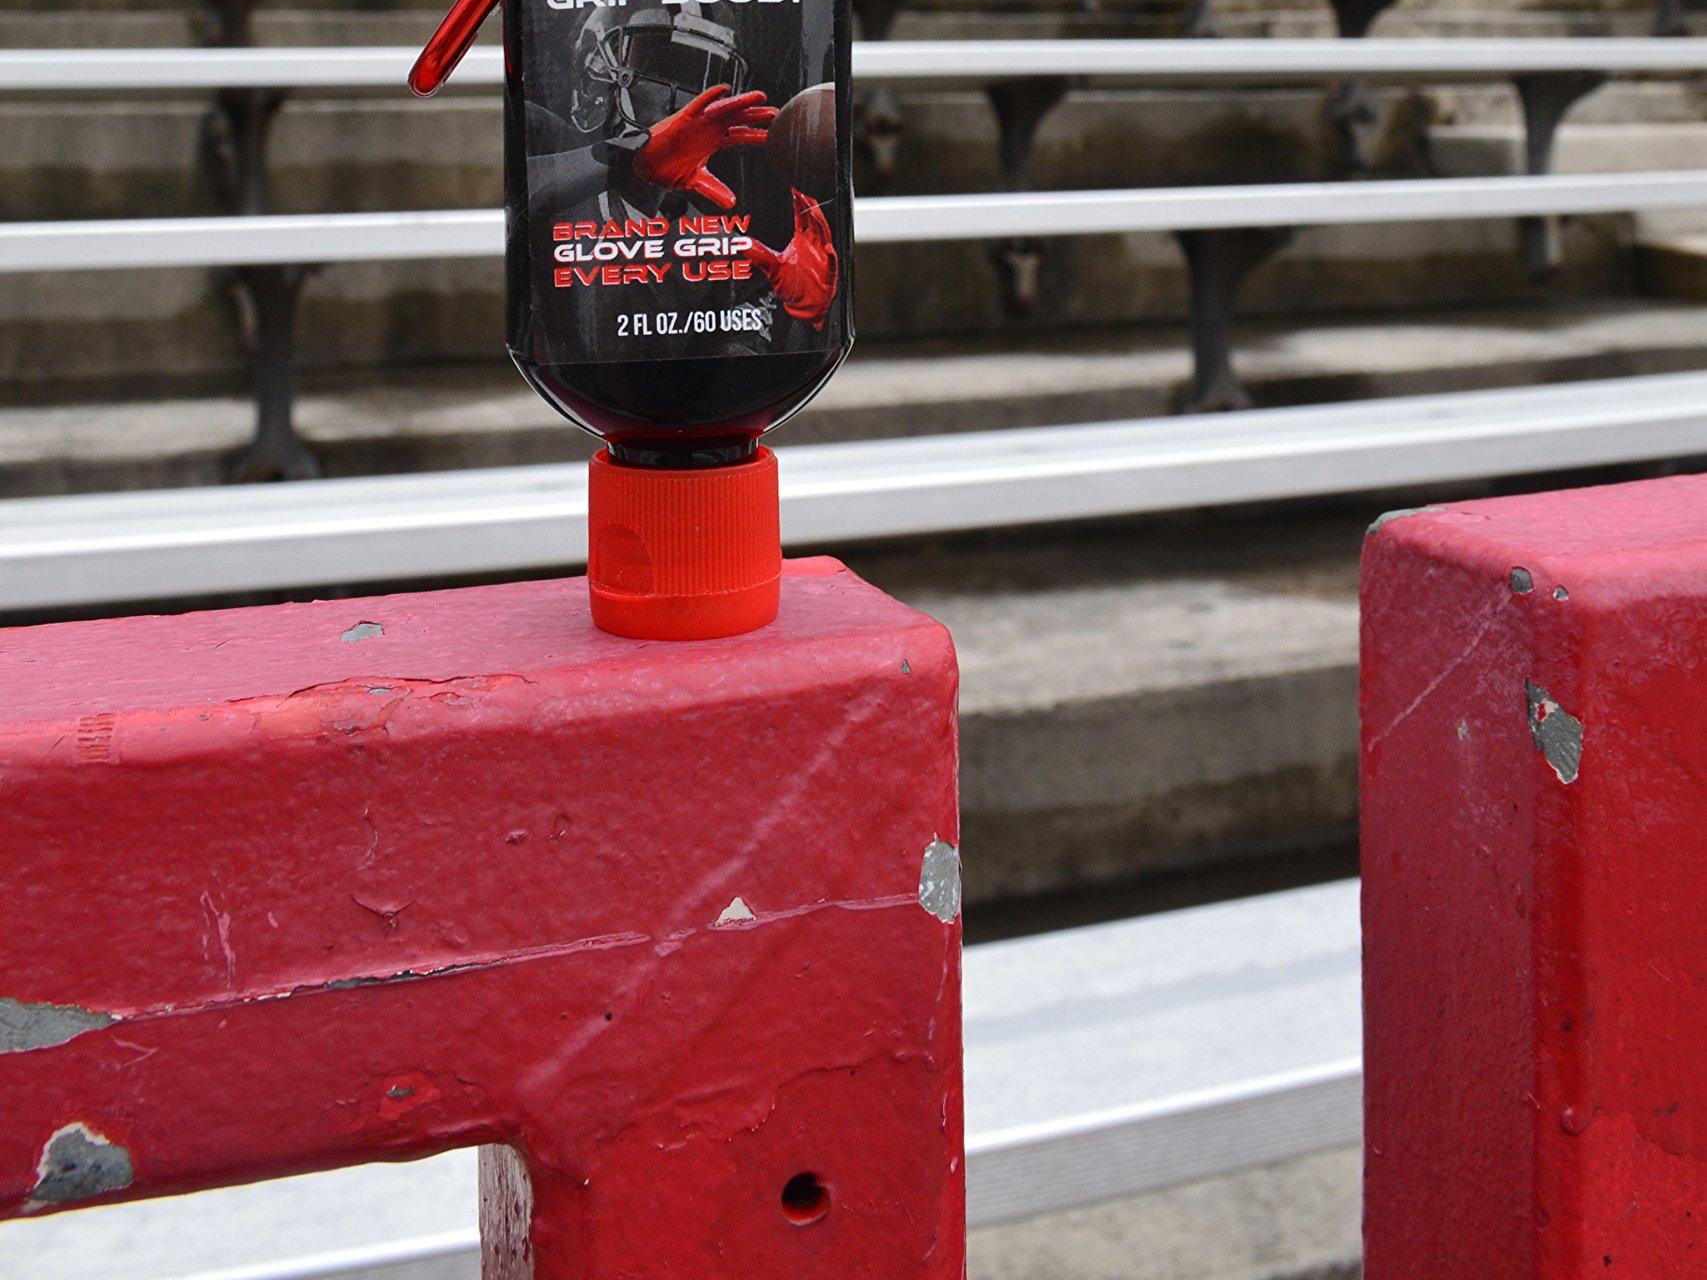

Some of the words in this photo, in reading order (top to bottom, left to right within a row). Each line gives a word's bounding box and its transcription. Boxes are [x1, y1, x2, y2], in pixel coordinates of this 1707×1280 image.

[553, 218, 668, 239] BRAND
[680, 215, 749, 235] NEW
[554, 240, 664, 262] GLOVE
[674, 236, 753, 257] GRIP
[554, 263, 671, 287] EVERY
[682, 260, 751, 281] USE
[617, 314, 629, 336] 2
[634, 313, 652, 336] FL
[720, 308, 762, 331] USES
